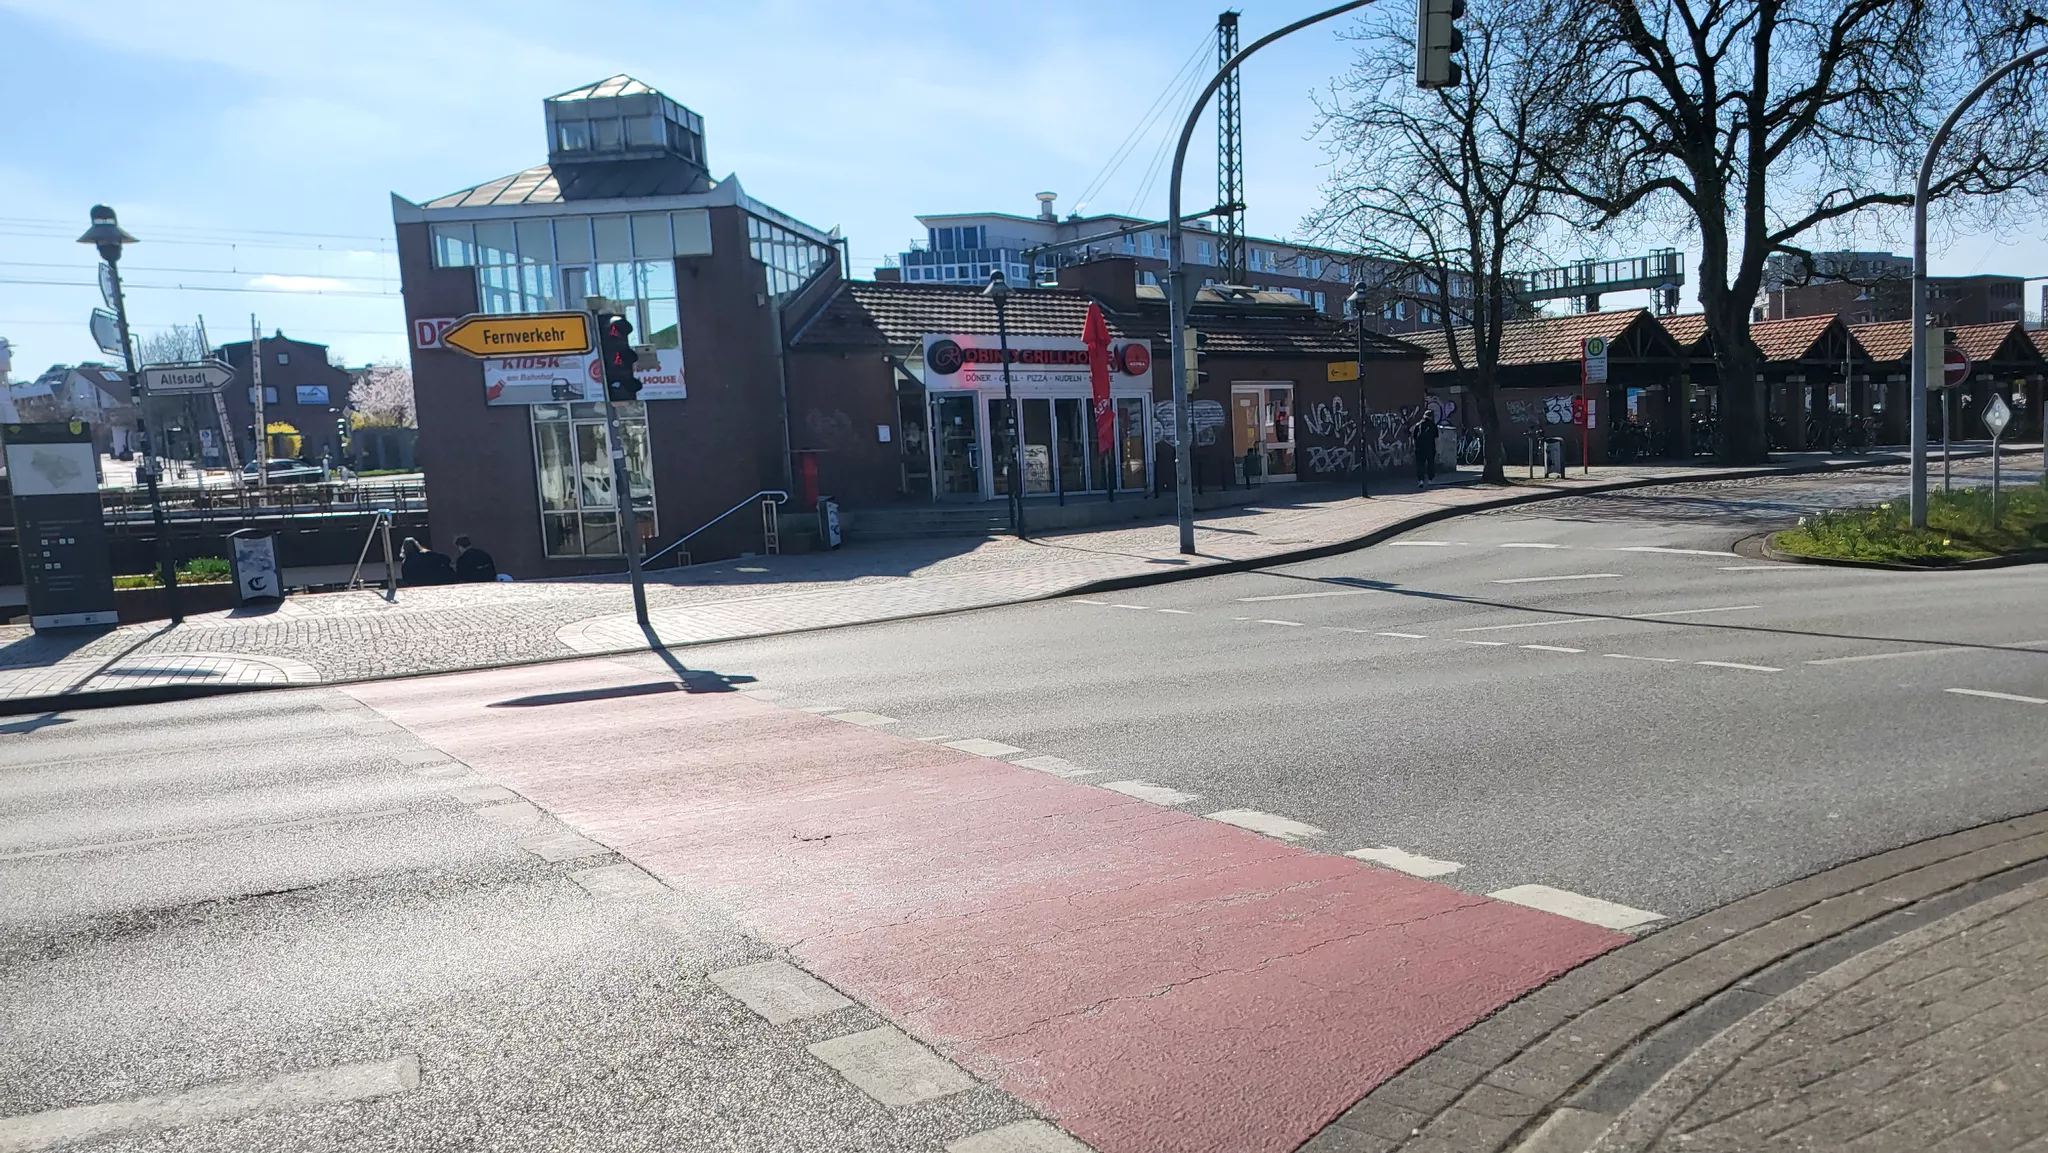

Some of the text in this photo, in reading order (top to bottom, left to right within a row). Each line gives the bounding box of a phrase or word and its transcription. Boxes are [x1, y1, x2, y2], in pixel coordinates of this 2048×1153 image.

[483, 326, 566, 345] Fernverkehr
[502, 355, 560, 370] KIOSK
[1022, 350, 1113, 366] GRILLHOE
[160, 373, 206, 385] Altstadt
[520, 373, 555, 382] Bahnhof
[1026, 374, 1048, 382] PIZZA
